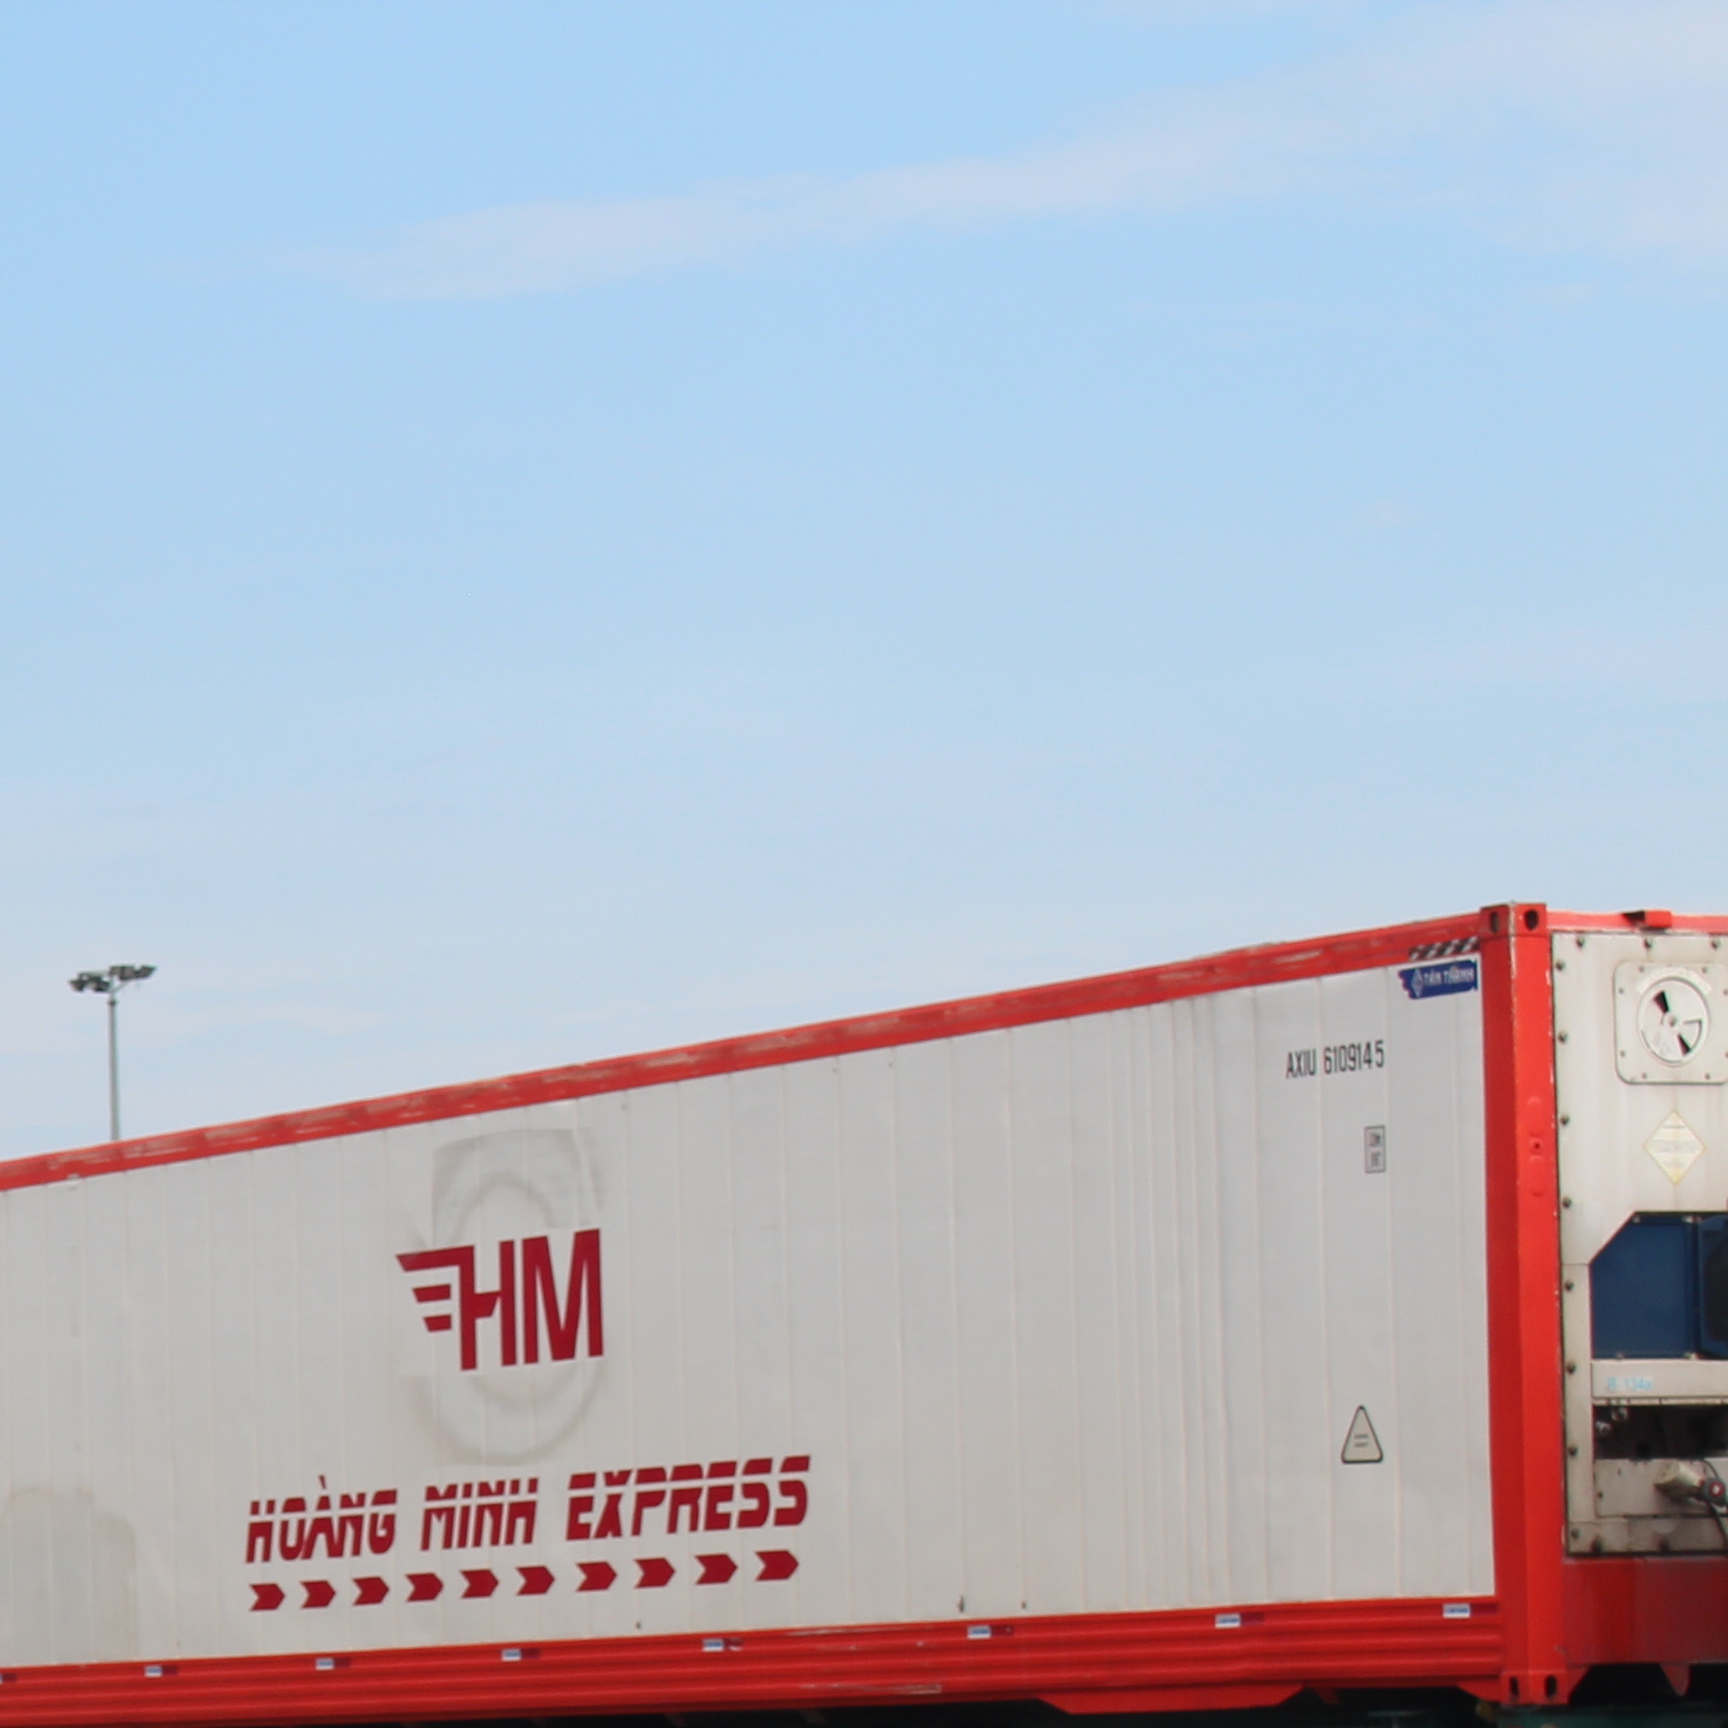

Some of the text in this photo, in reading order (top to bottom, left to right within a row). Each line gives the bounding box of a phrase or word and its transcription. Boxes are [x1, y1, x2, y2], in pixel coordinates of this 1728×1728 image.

[1286, 1039, 1384, 1078] AXIU 6109145
[396, 1228, 604, 1371] HM
[245, 1455, 811, 1563] HOÀNG MINH EXPRESS
